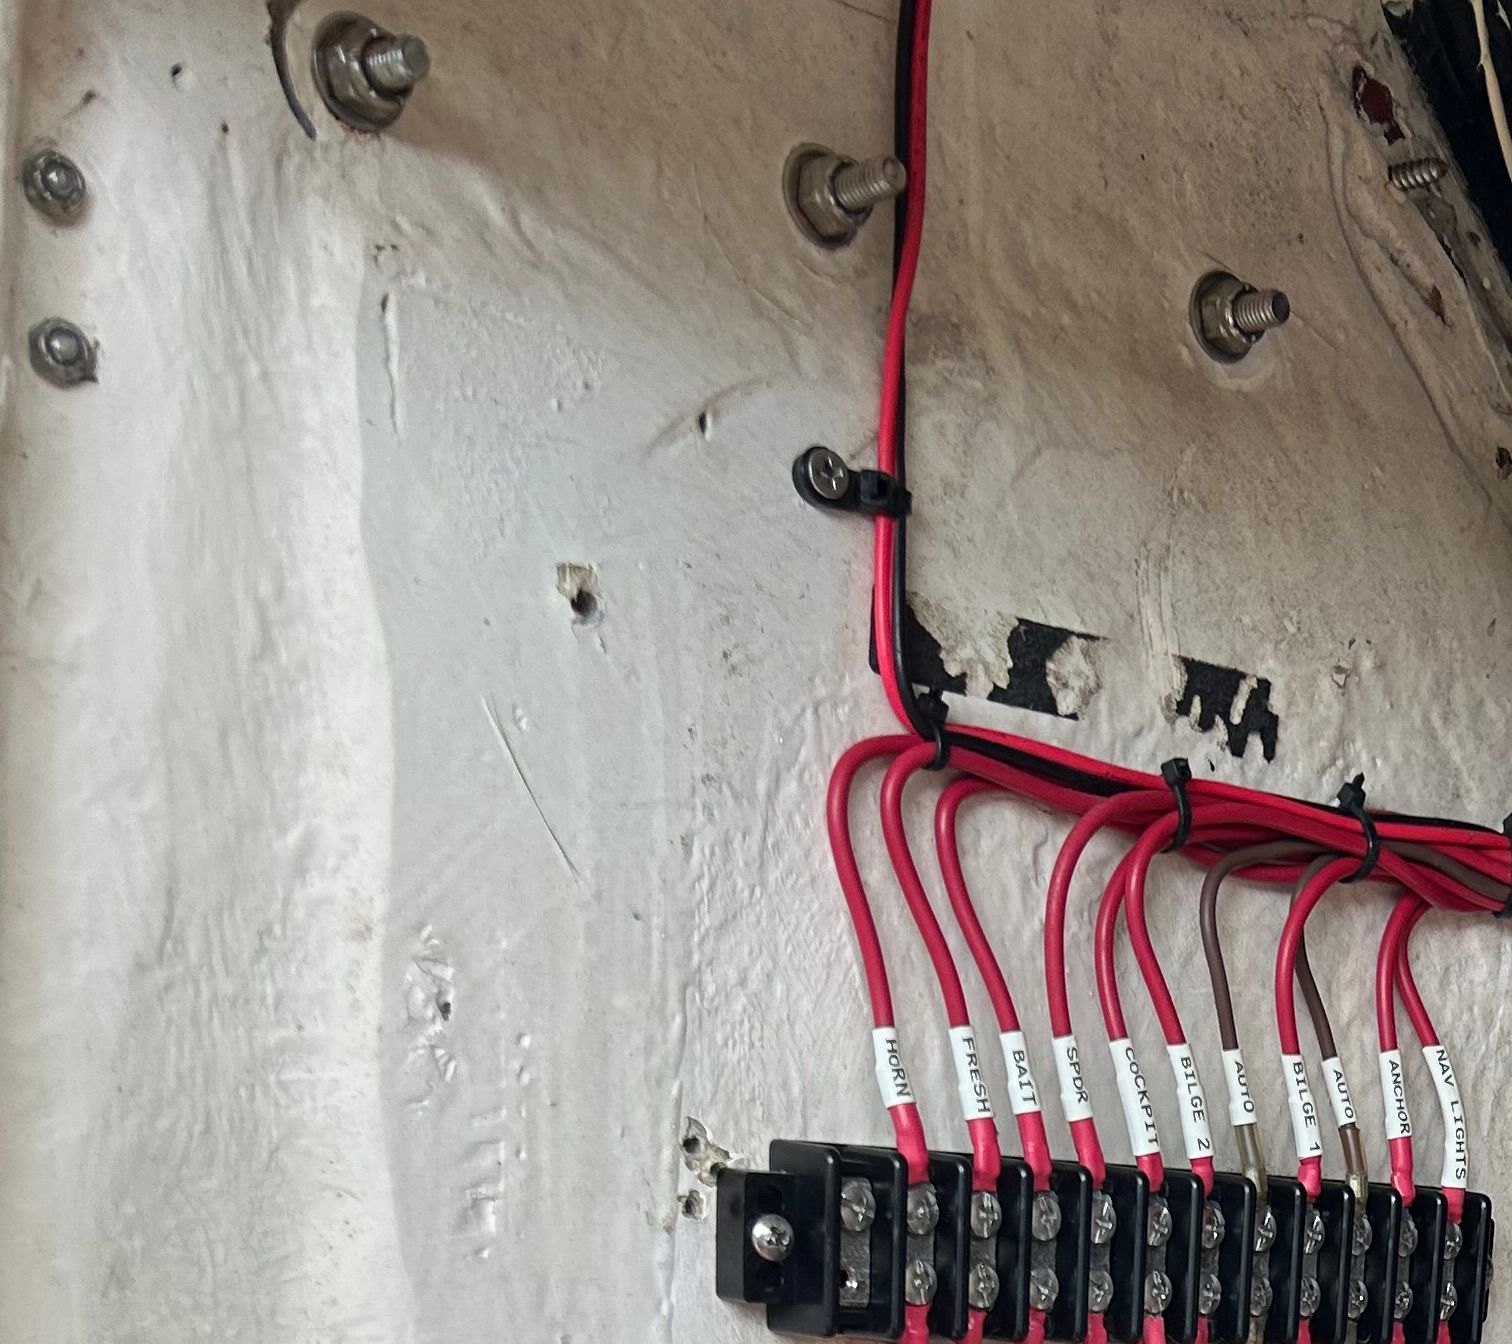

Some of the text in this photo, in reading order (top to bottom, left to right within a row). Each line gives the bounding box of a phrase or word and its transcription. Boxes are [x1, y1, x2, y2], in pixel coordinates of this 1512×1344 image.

[885, 1038, 911, 1097] HORN
[962, 1037, 990, 1113] FRESH
[1012, 1050, 1038, 1105] BAIT
[1067, 1047, 1088, 1104] SPDR
[1125, 1047, 1159, 1146] COCKPIT
[1181, 1056, 1210, 1151] BILGE 2
[1234, 1060, 1255, 1113] AUTO
[1333, 1069, 1354, 1119] AUTO
[1389, 1059, 1411, 1134] ANCHOR
[1293, 1062, 1321, 1152] BILGE 1
[1436, 1049, 1466, 1180] NAV LIGHTS
